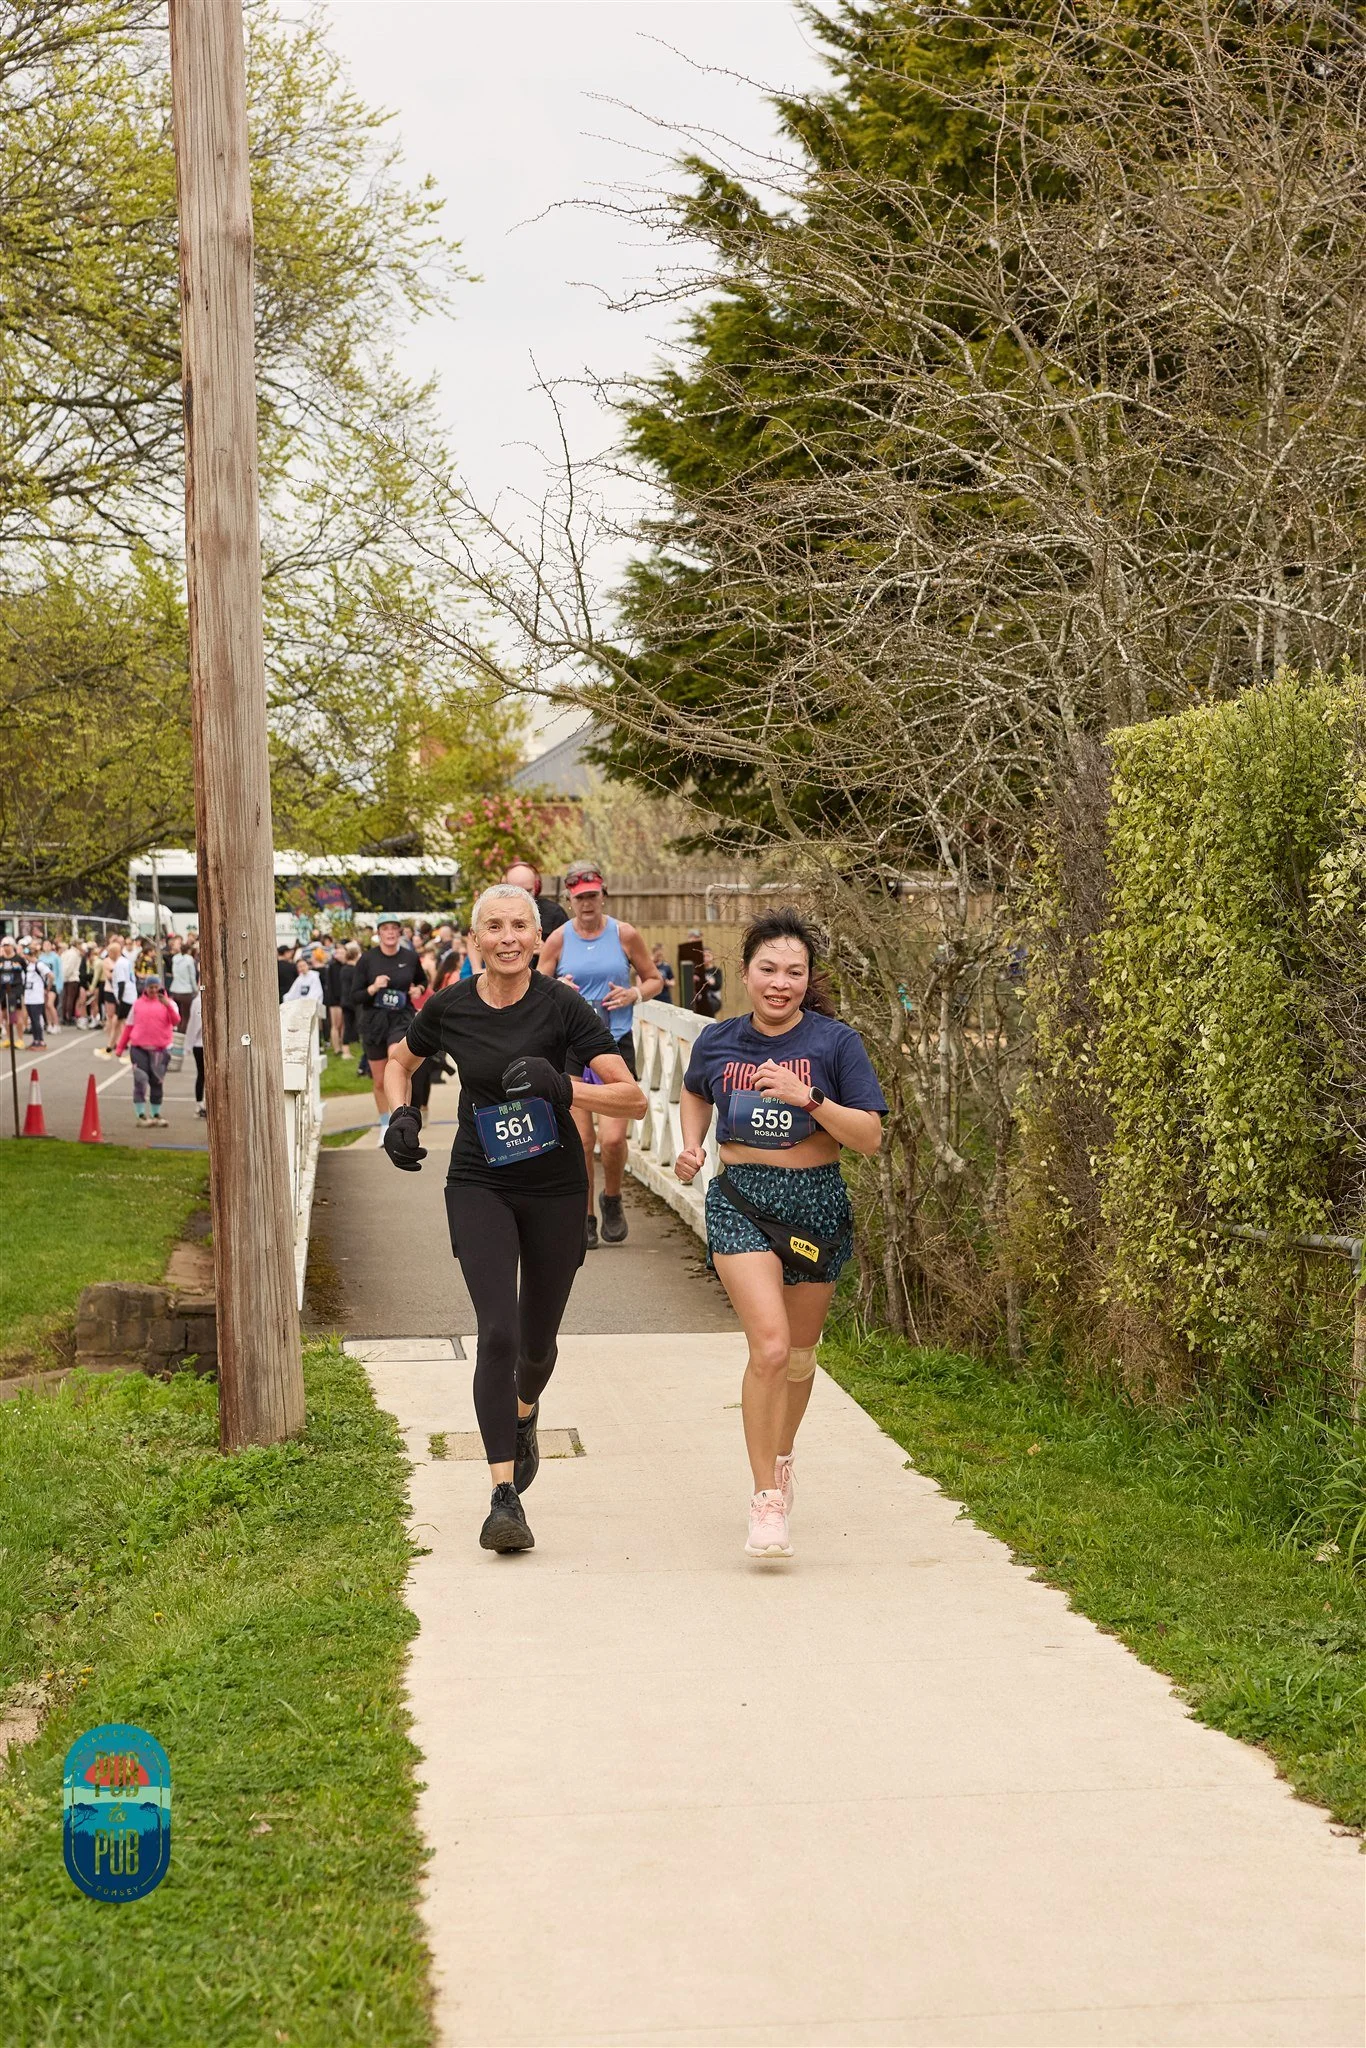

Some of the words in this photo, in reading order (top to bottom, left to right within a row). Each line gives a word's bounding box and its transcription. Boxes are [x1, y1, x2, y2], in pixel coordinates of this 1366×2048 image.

[723, 1061, 757, 1092] PUB
[495, 1113, 534, 1140] 561
[750, 1107, 793, 1130] 559
[506, 1136, 533, 1147] STELLA
[754, 1129, 790, 1138] ROSALAE
